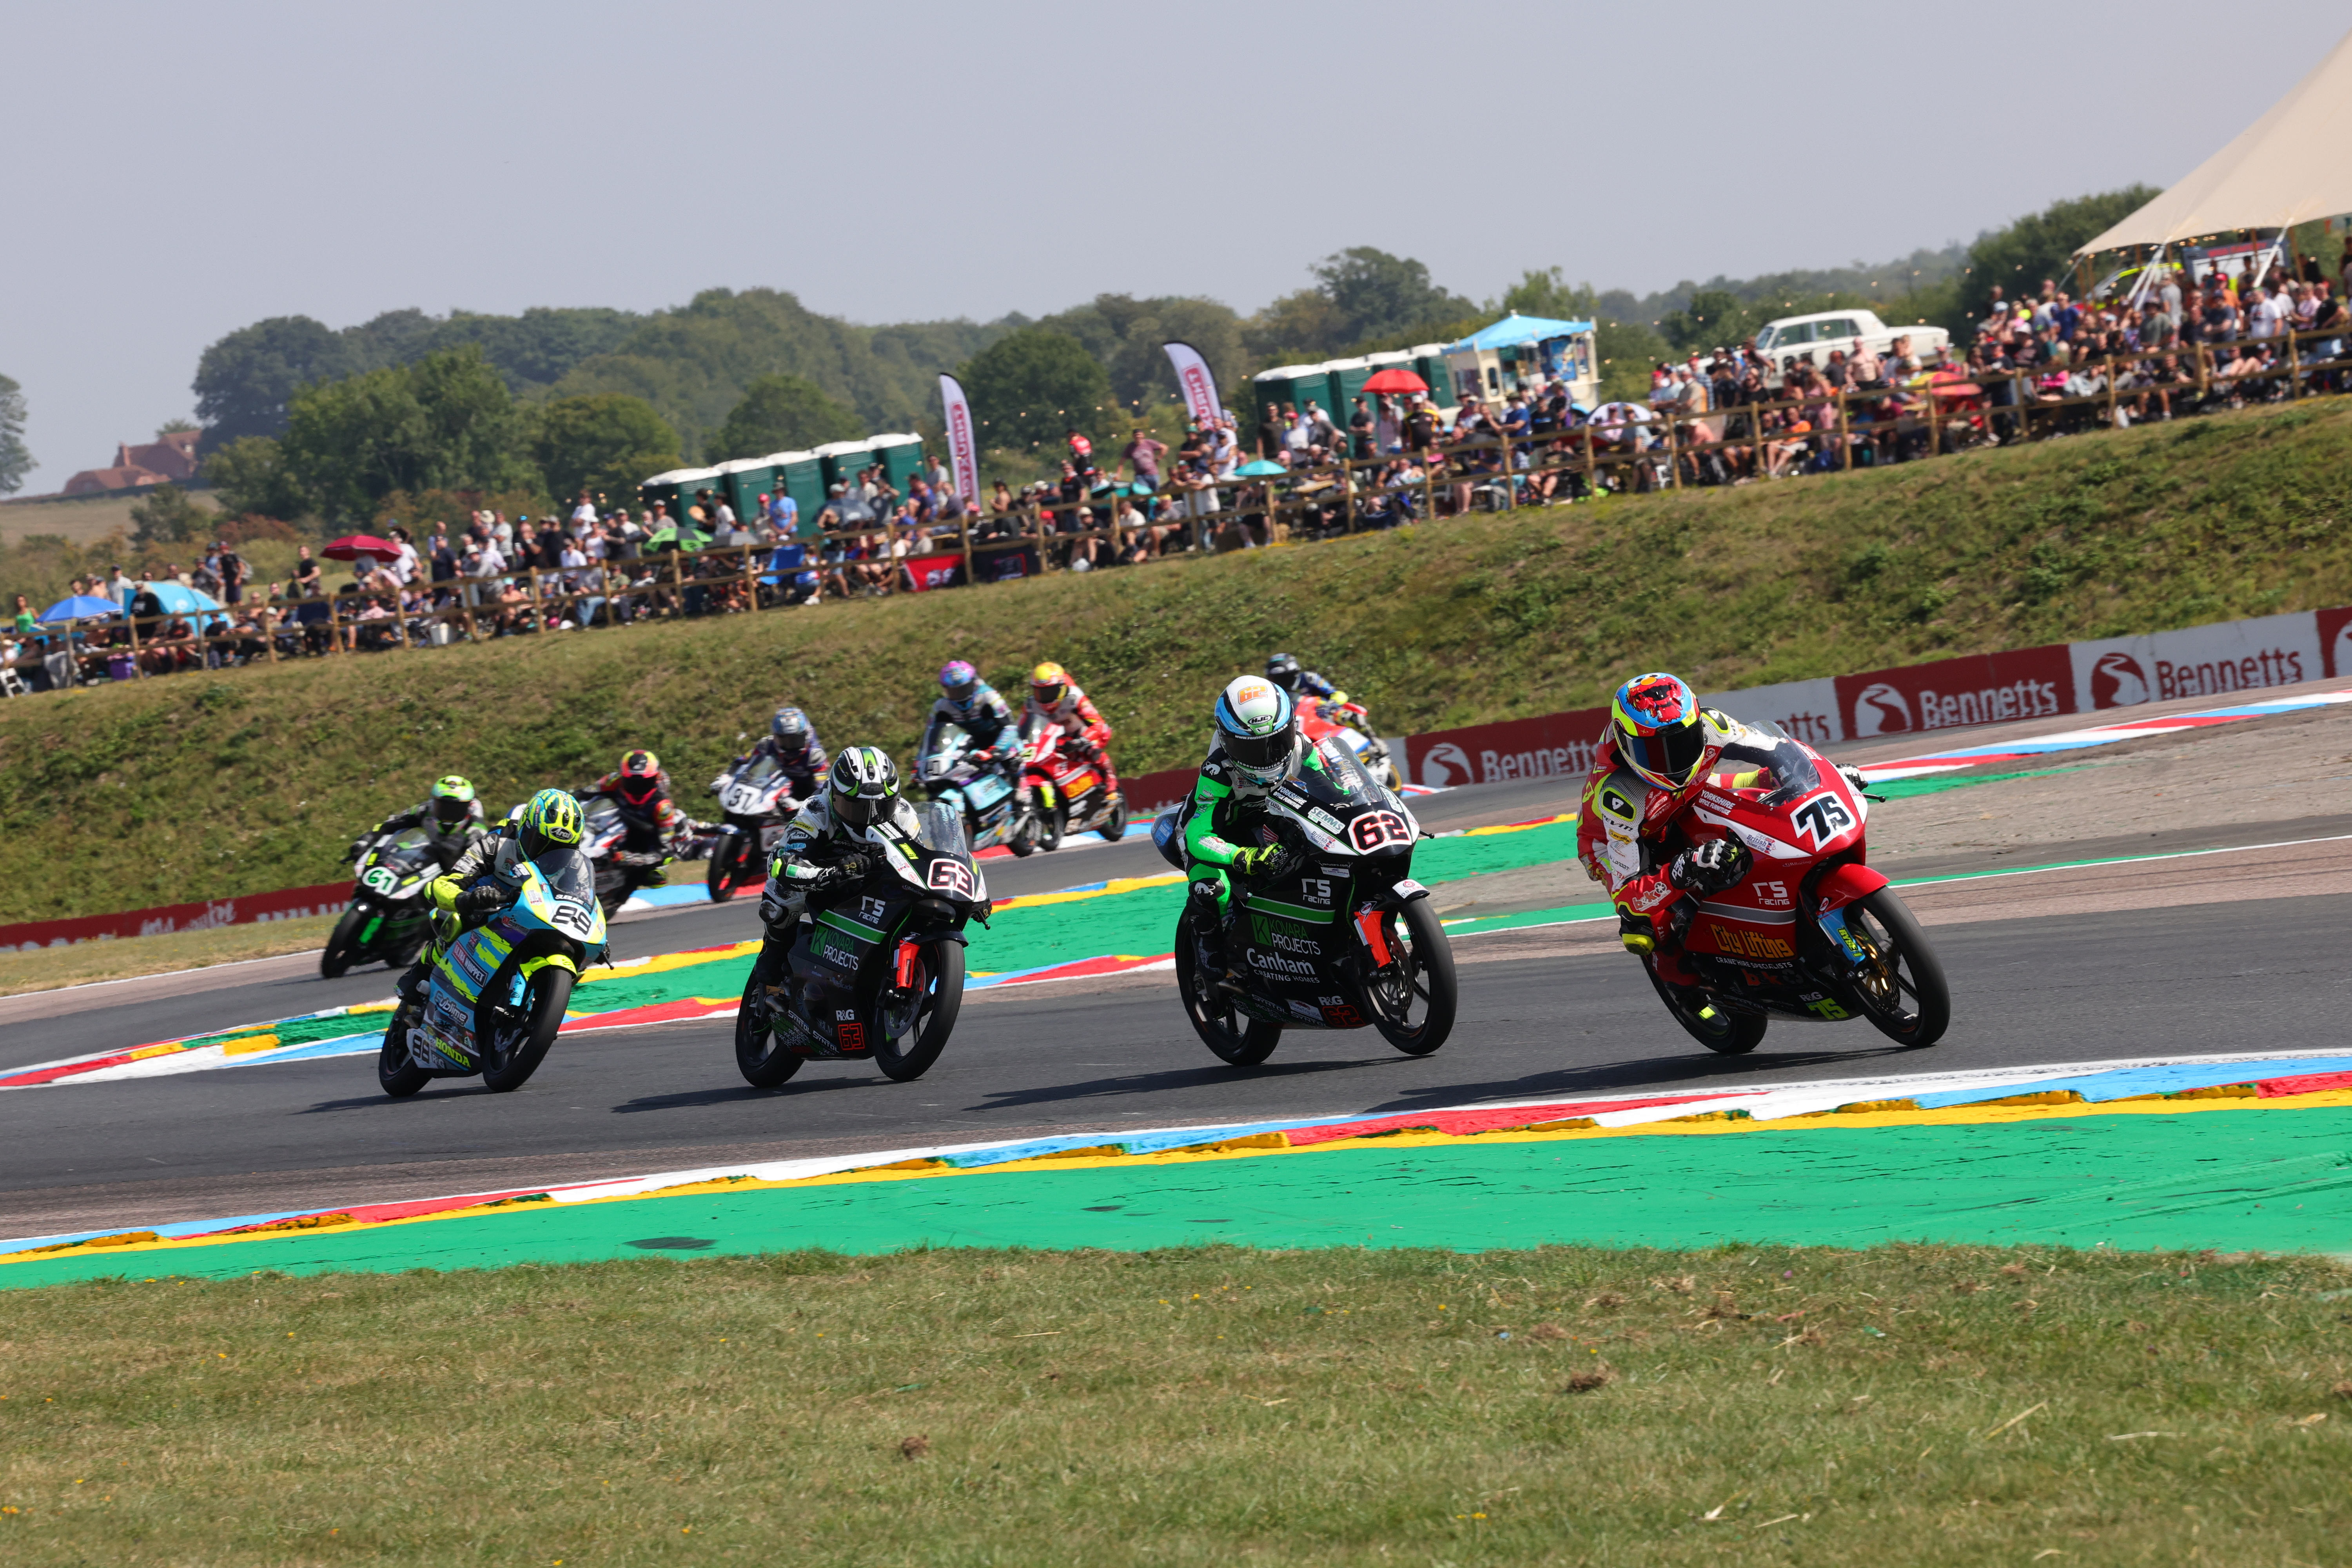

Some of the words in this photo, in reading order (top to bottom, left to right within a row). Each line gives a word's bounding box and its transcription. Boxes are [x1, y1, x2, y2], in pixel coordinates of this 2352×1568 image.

[2157, 648, 2302, 699] Bennetts
[1238, 686, 1268, 704] 62
[1920, 679, 2057, 730] Bennetts
[1273, 791, 1283, 801] OFFICE
[1282, 797, 1302, 810] FURNITURE
[1277, 785, 1307, 806] YORKSHIRE
[1702, 789, 1736, 810] YORKSHIRE
[1698, 798, 1710, 809] OFFICE
[1709, 802, 1731, 816] FURNITURE
[1310, 807, 1344, 831] SEMMS
[1795, 795, 1850, 843] 75
[551, 828, 571, 838] Arai
[1311, 831, 1328, 844] British
[1352, 813, 1410, 851] 62
[1746, 834, 1766, 846] British
[1220, 845, 1231, 854] USA
[1746, 840, 1757, 848] Talent
[1613, 860, 1630, 871] LONDON
[931, 861, 973, 897] 63
[555, 894, 584, 905] SUBLIME
[1303, 894, 1331, 906] racing
[1758, 898, 1790, 906] racing
[551, 905, 592, 936] 88
[858, 911, 880, 924] racing
[1269, 918, 1309, 940] KOVARA
[826, 930, 854, 955] KOVARA
[1271, 932, 1321, 956] PROJECTS
[1710, 924, 1745, 955] City
[1739, 929, 1795, 958] Lifting
[454, 944, 466, 964] ULTRA
[822, 944, 859, 971] PROJECTS
[1246, 947, 1316, 975] Canham
[1715, 956, 1736, 965] CRANE
[1737, 960, 1751, 968] HIRE
[464, 956, 485, 982] WHIPPET
[1254, 969, 1291, 982] CREATING
[1293, 975, 1321, 984] HOMES
[435, 991, 467, 1022] Sublime
[1251, 993, 1289, 1014] SYNTOL
[1318, 995, 1345, 1006] R&G
[1798, 991, 1823, 1002] R&G
[835, 1009, 855, 1021] R&G
[1290, 1010, 1327, 1027] SYNTOL
[1321, 1004, 1367, 1027] 62
[1805, 997, 1849, 1020] 75
[788, 1009, 811, 1035] SYNTOL
[812, 1030, 840, 1054] SYNTOL
[838, 1022, 866, 1051] 63
[412, 1034, 430, 1065] 88
[435, 1036, 472, 1069] HONDA
[431, 1053, 445, 1070] R&G
